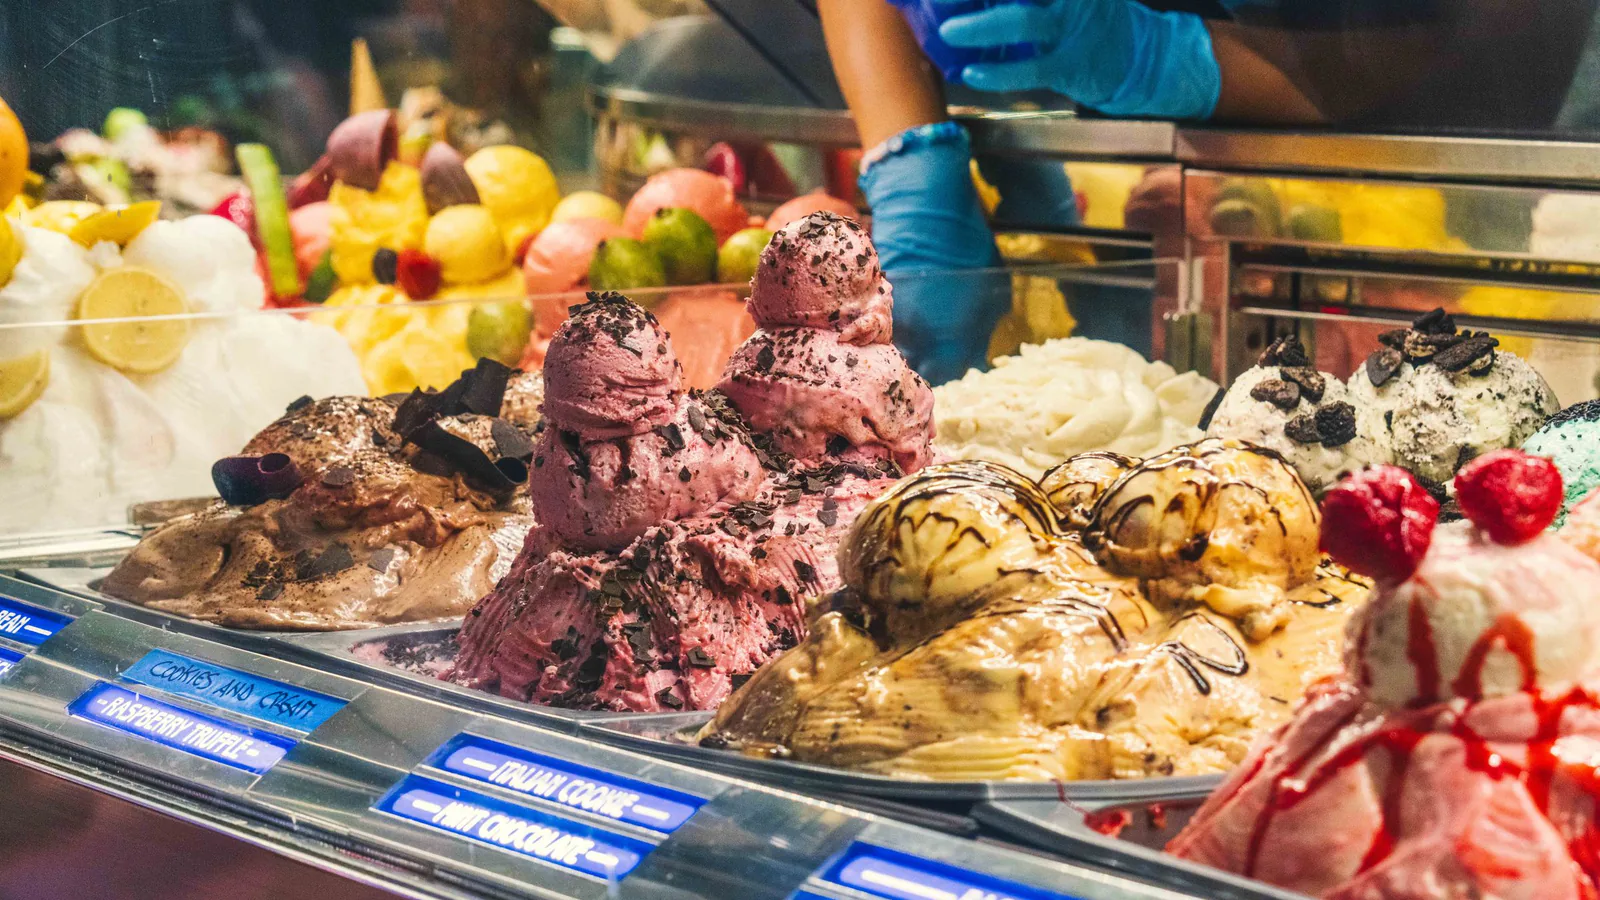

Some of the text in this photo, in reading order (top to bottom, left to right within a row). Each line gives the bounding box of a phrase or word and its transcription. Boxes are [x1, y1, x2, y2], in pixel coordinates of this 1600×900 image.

[149, 660, 220, 690] COOKIES
[212, 678, 255, 702] AND
[100, 696, 254, 760] RASPBERRY TRUFFLE
[487, 760, 641, 819] ITALIAN COOKIE
[431, 800, 596, 866] MINT CHOCOLATE
